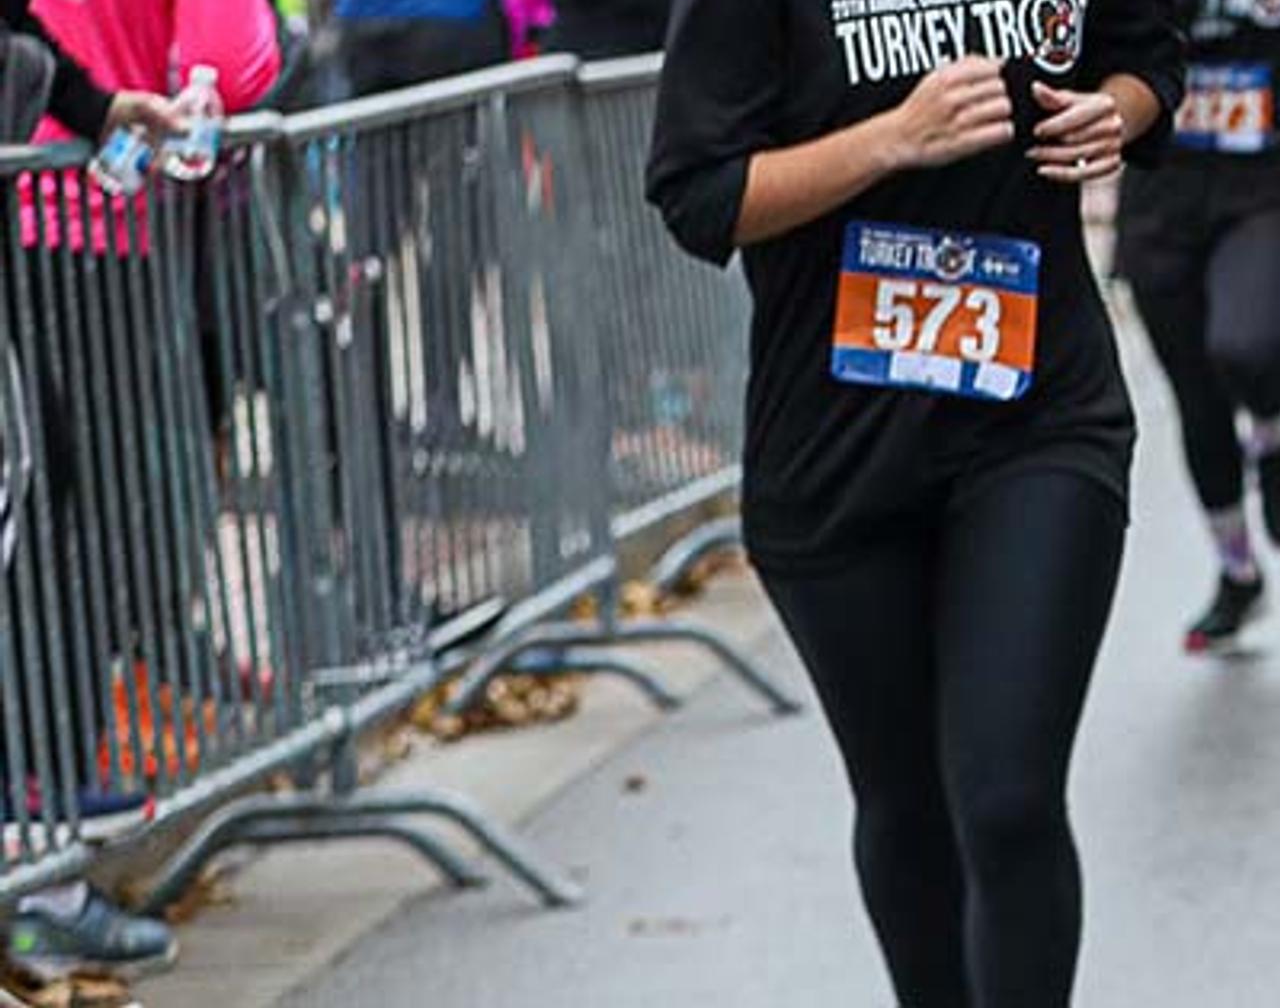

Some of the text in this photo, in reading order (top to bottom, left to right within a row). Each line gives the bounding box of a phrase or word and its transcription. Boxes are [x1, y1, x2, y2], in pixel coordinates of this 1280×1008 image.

[835, 5, 967, 85] TURKEY
[860, 237, 913, 268] TURKEY
[872, 278, 1002, 364] 573
